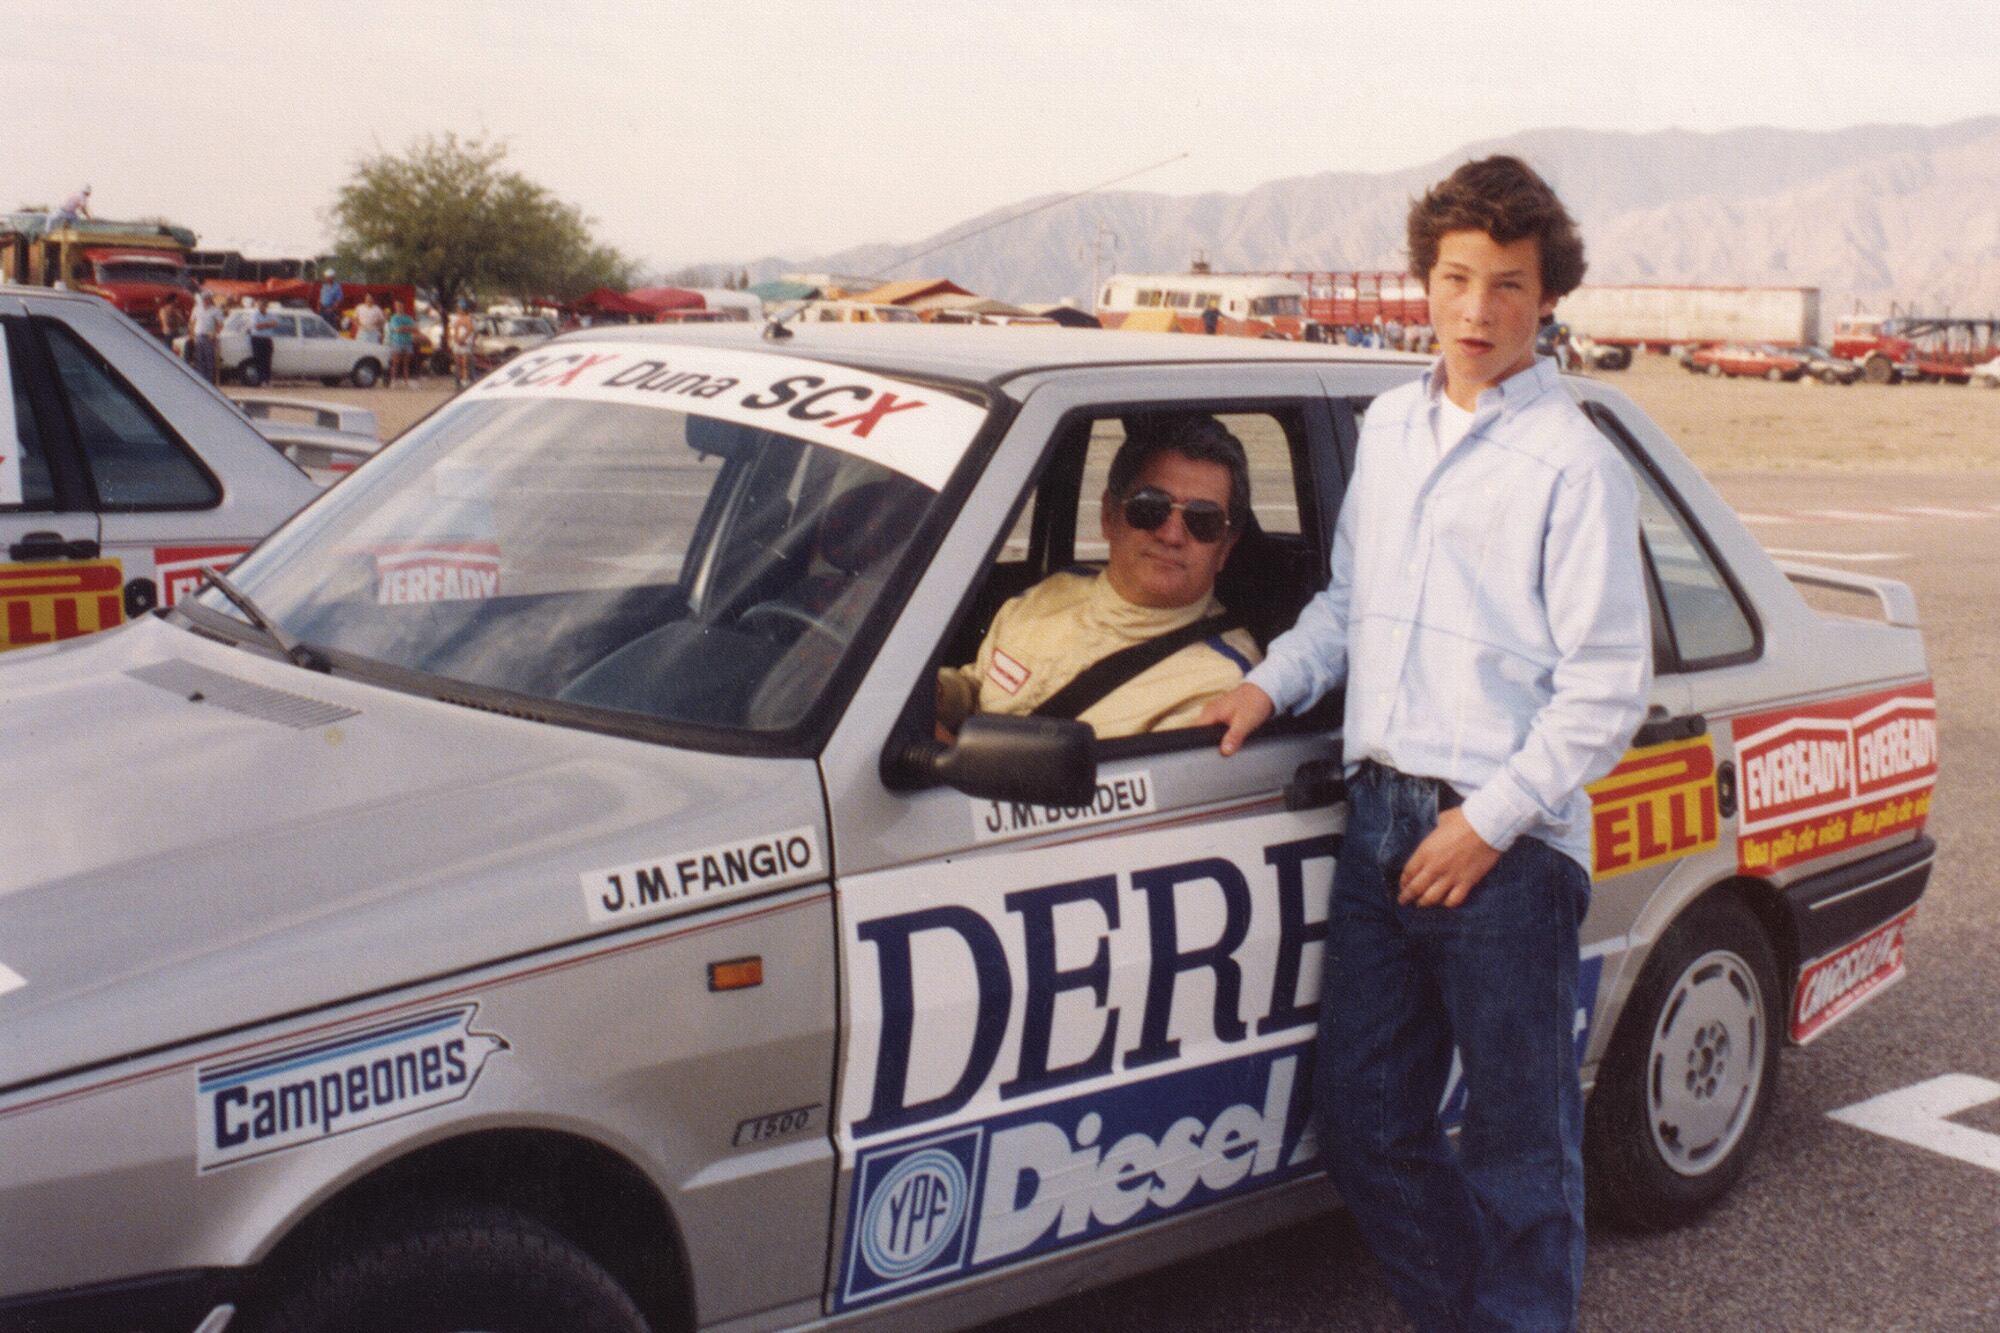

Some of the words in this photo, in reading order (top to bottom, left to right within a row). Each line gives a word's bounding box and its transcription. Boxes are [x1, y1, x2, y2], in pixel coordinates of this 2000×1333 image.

[485, 353, 622, 391] SCX
[602, 359, 740, 399] Duna
[741, 373, 927, 439] SCX
[1747, 739, 1847, 810] EVEREADY
[602, 836, 811, 912] J.M.FANGIO
[214, 1038, 468, 1149] Campeones
[752, 1108, 809, 1138] 1500
[972, 1054, 1298, 1265] Diesel
[889, 1173, 949, 1255] YPF
